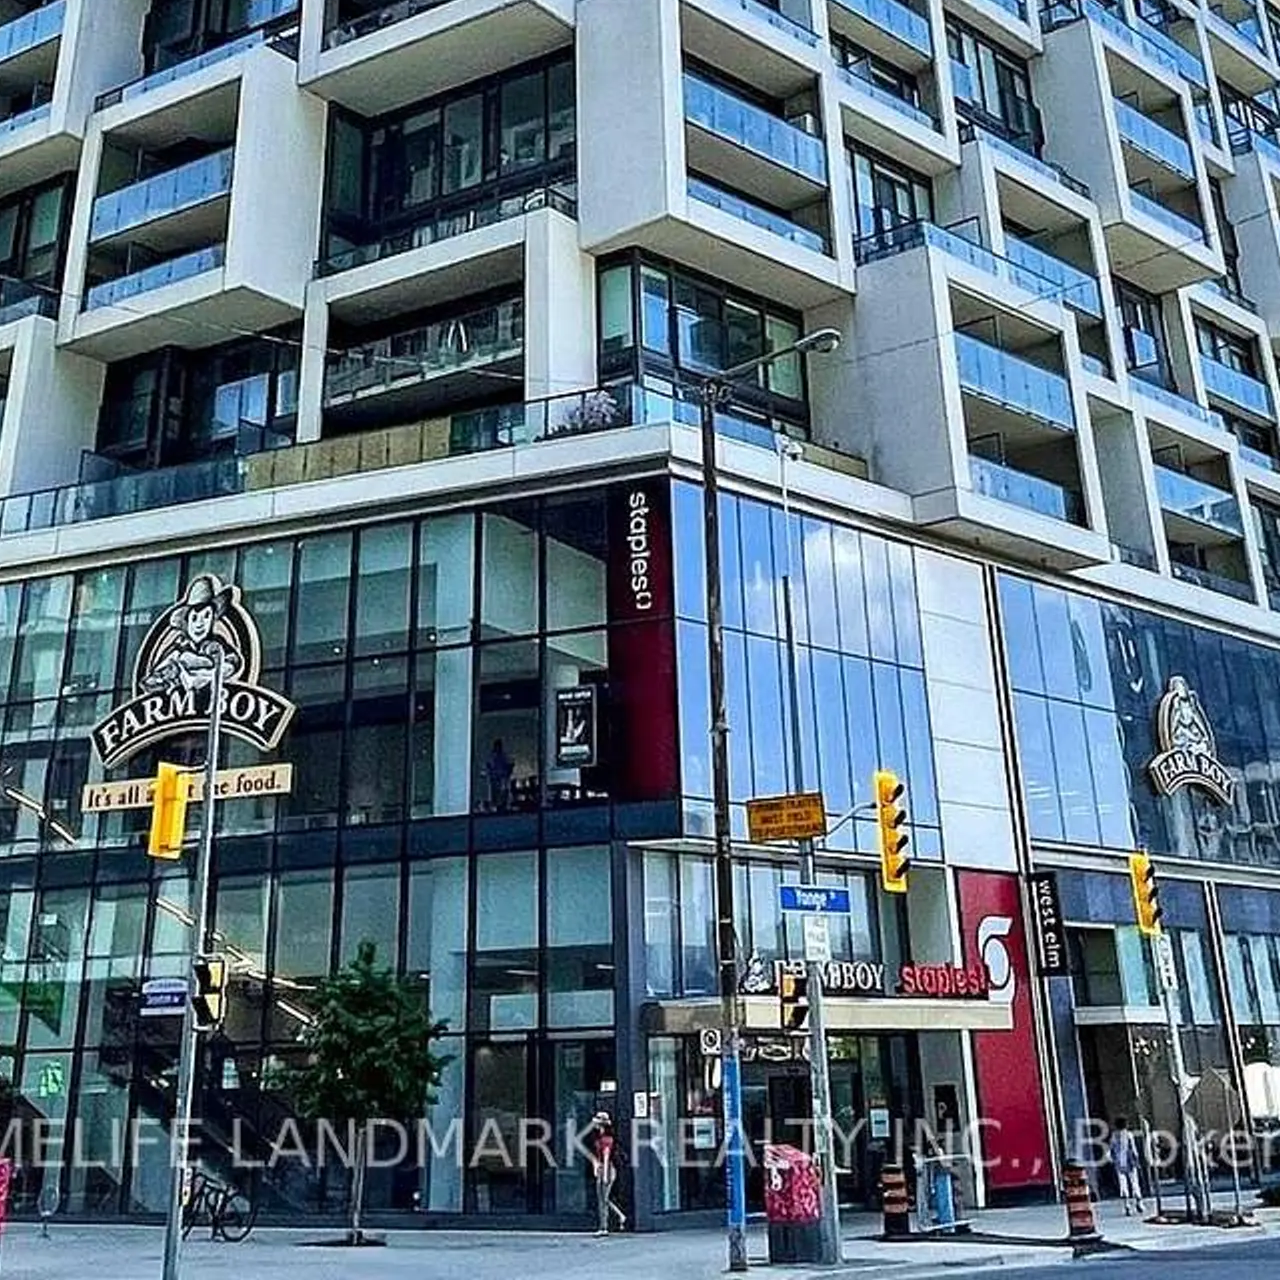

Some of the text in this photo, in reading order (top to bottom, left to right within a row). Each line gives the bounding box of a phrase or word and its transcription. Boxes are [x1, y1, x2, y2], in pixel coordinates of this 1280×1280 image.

[100, 688, 281, 754] FARM BOY
[88, 786, 111, 808] It's
[117, 784, 140, 805] all
[236, 772, 281, 794] food.
[1159, 751, 1231, 793] FARM BOY
[795, 889, 827, 911] Yonge
[1038, 880, 1061, 967] west elm
